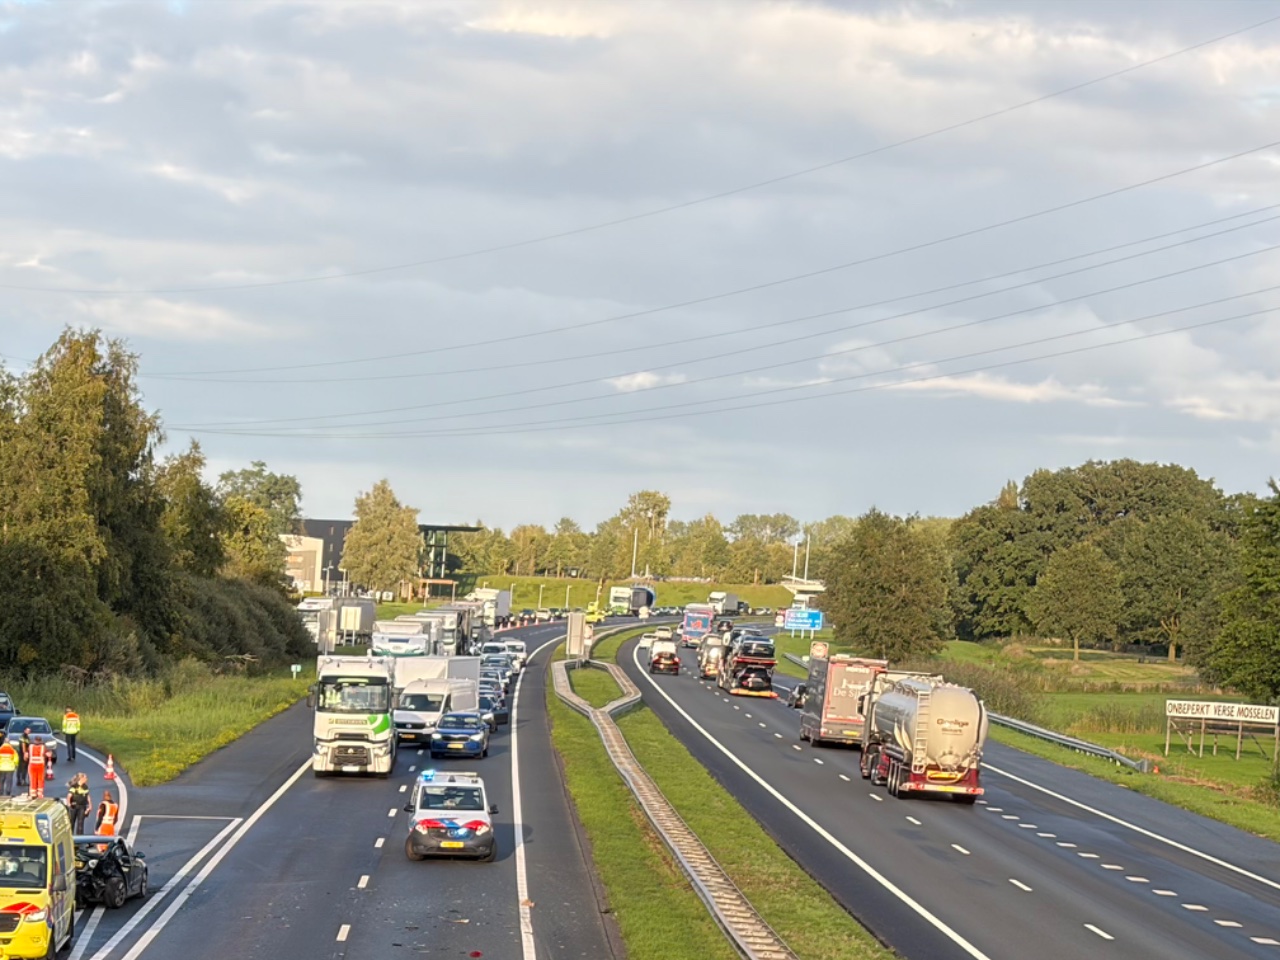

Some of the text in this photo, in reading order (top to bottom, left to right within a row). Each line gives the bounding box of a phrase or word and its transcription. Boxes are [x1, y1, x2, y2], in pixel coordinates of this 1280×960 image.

[1167, 702, 1276, 720] ONBEPERKT VERSE MOSSELEN
